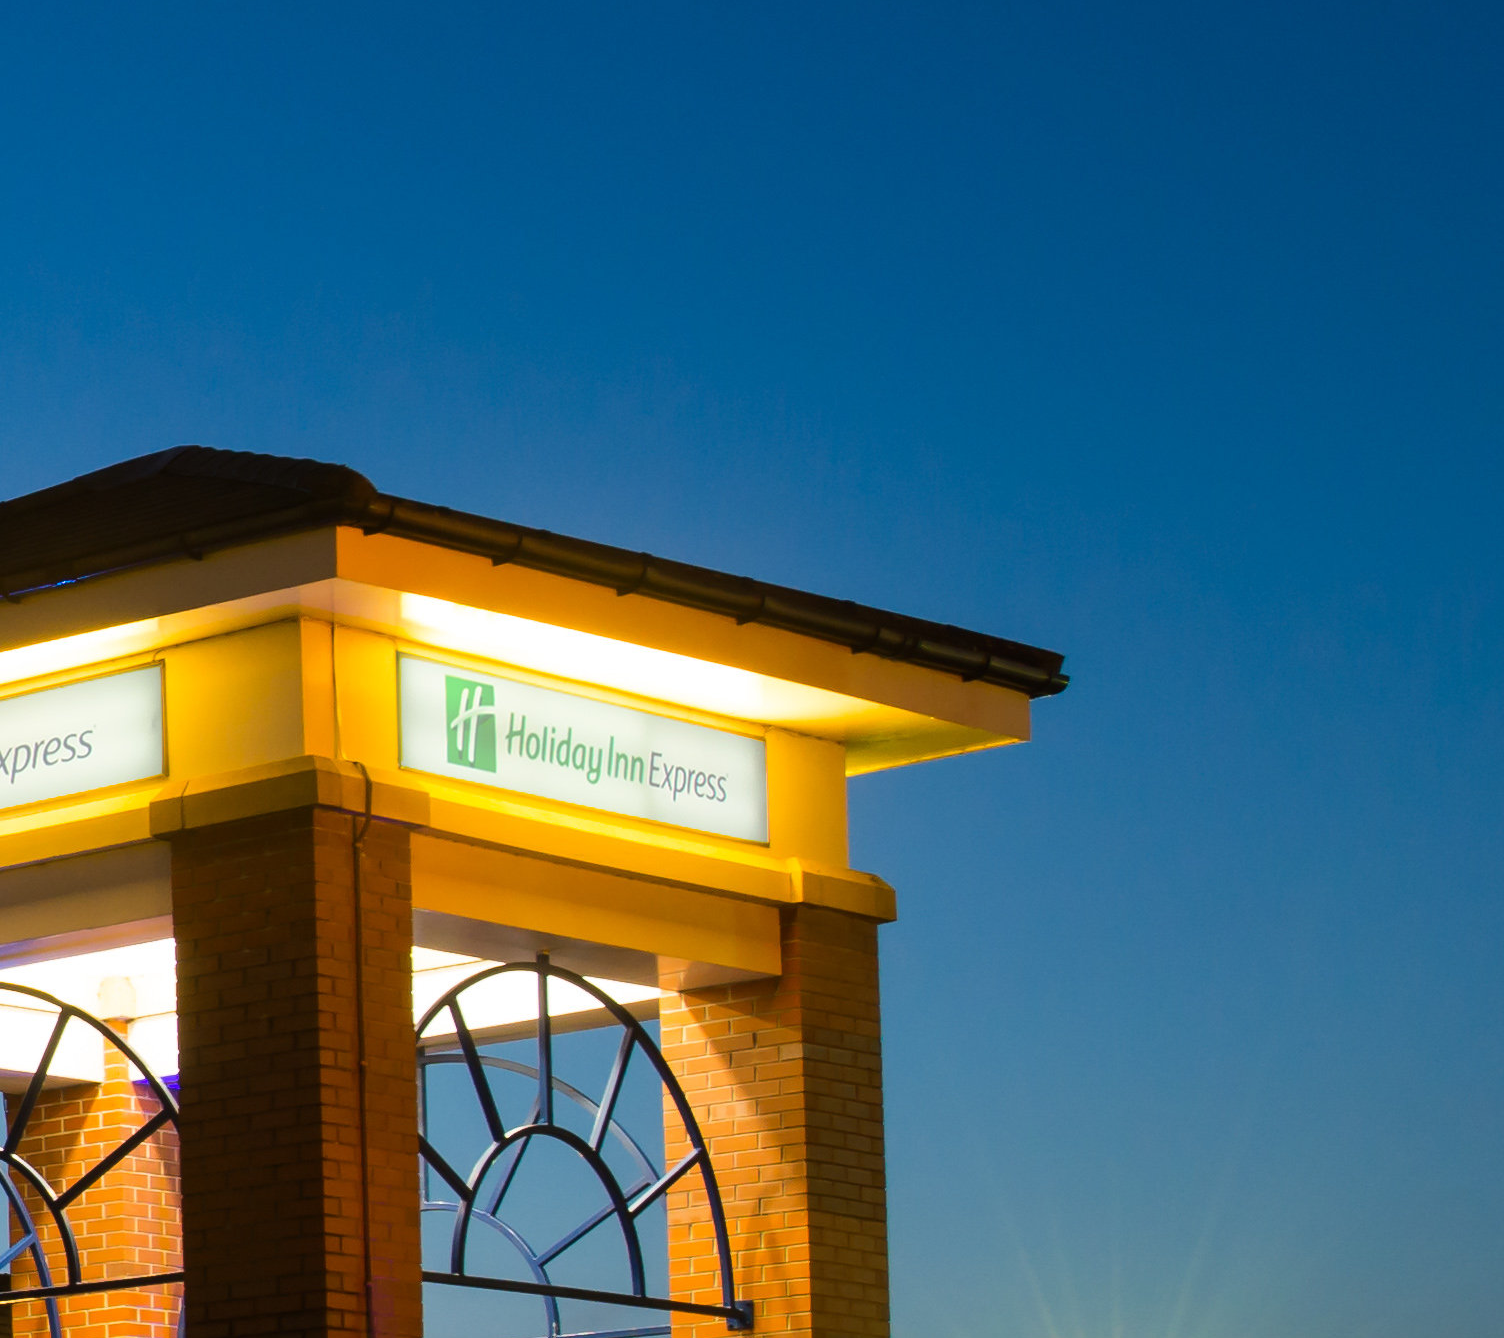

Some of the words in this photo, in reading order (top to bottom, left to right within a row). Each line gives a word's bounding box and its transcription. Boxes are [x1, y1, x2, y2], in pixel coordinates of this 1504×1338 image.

[505, 711, 604, 785] Holiday
[607, 735, 644, 784] Inn
[648, 751, 728, 803] Express
